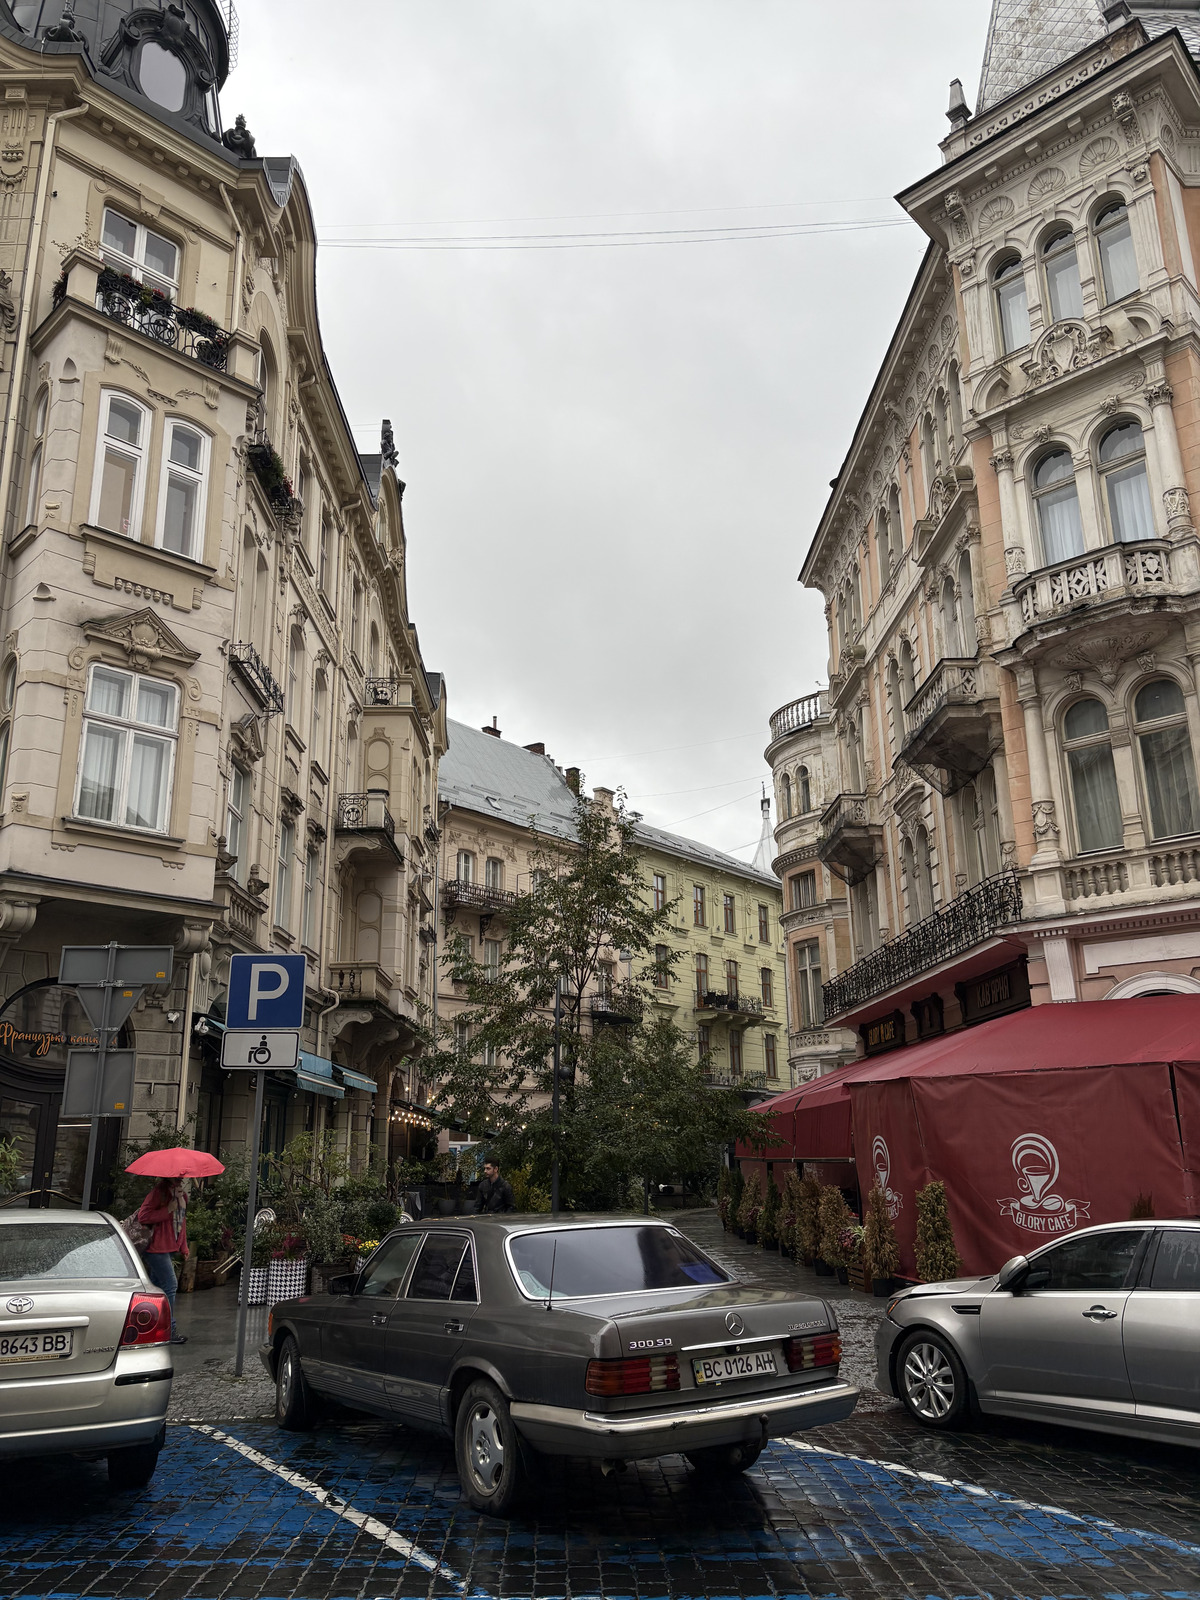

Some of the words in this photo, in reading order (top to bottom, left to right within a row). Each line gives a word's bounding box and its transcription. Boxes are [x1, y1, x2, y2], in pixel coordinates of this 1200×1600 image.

[248, 963, 290, 1021] P
[1015, 1211, 1046, 1231] GLORY
[1047, 1213, 1074, 1231] CAFE
[0, 1337, 39, 1355] 8643
[42, 1335, 66, 1352] BB
[629, 1340, 654, 1350] 300
[657, 1338, 672, 1347] SD
[702, 1359, 723, 1379] BC
[724, 1355, 753, 1376] 0126
[756, 1353, 773, 1373] AH
